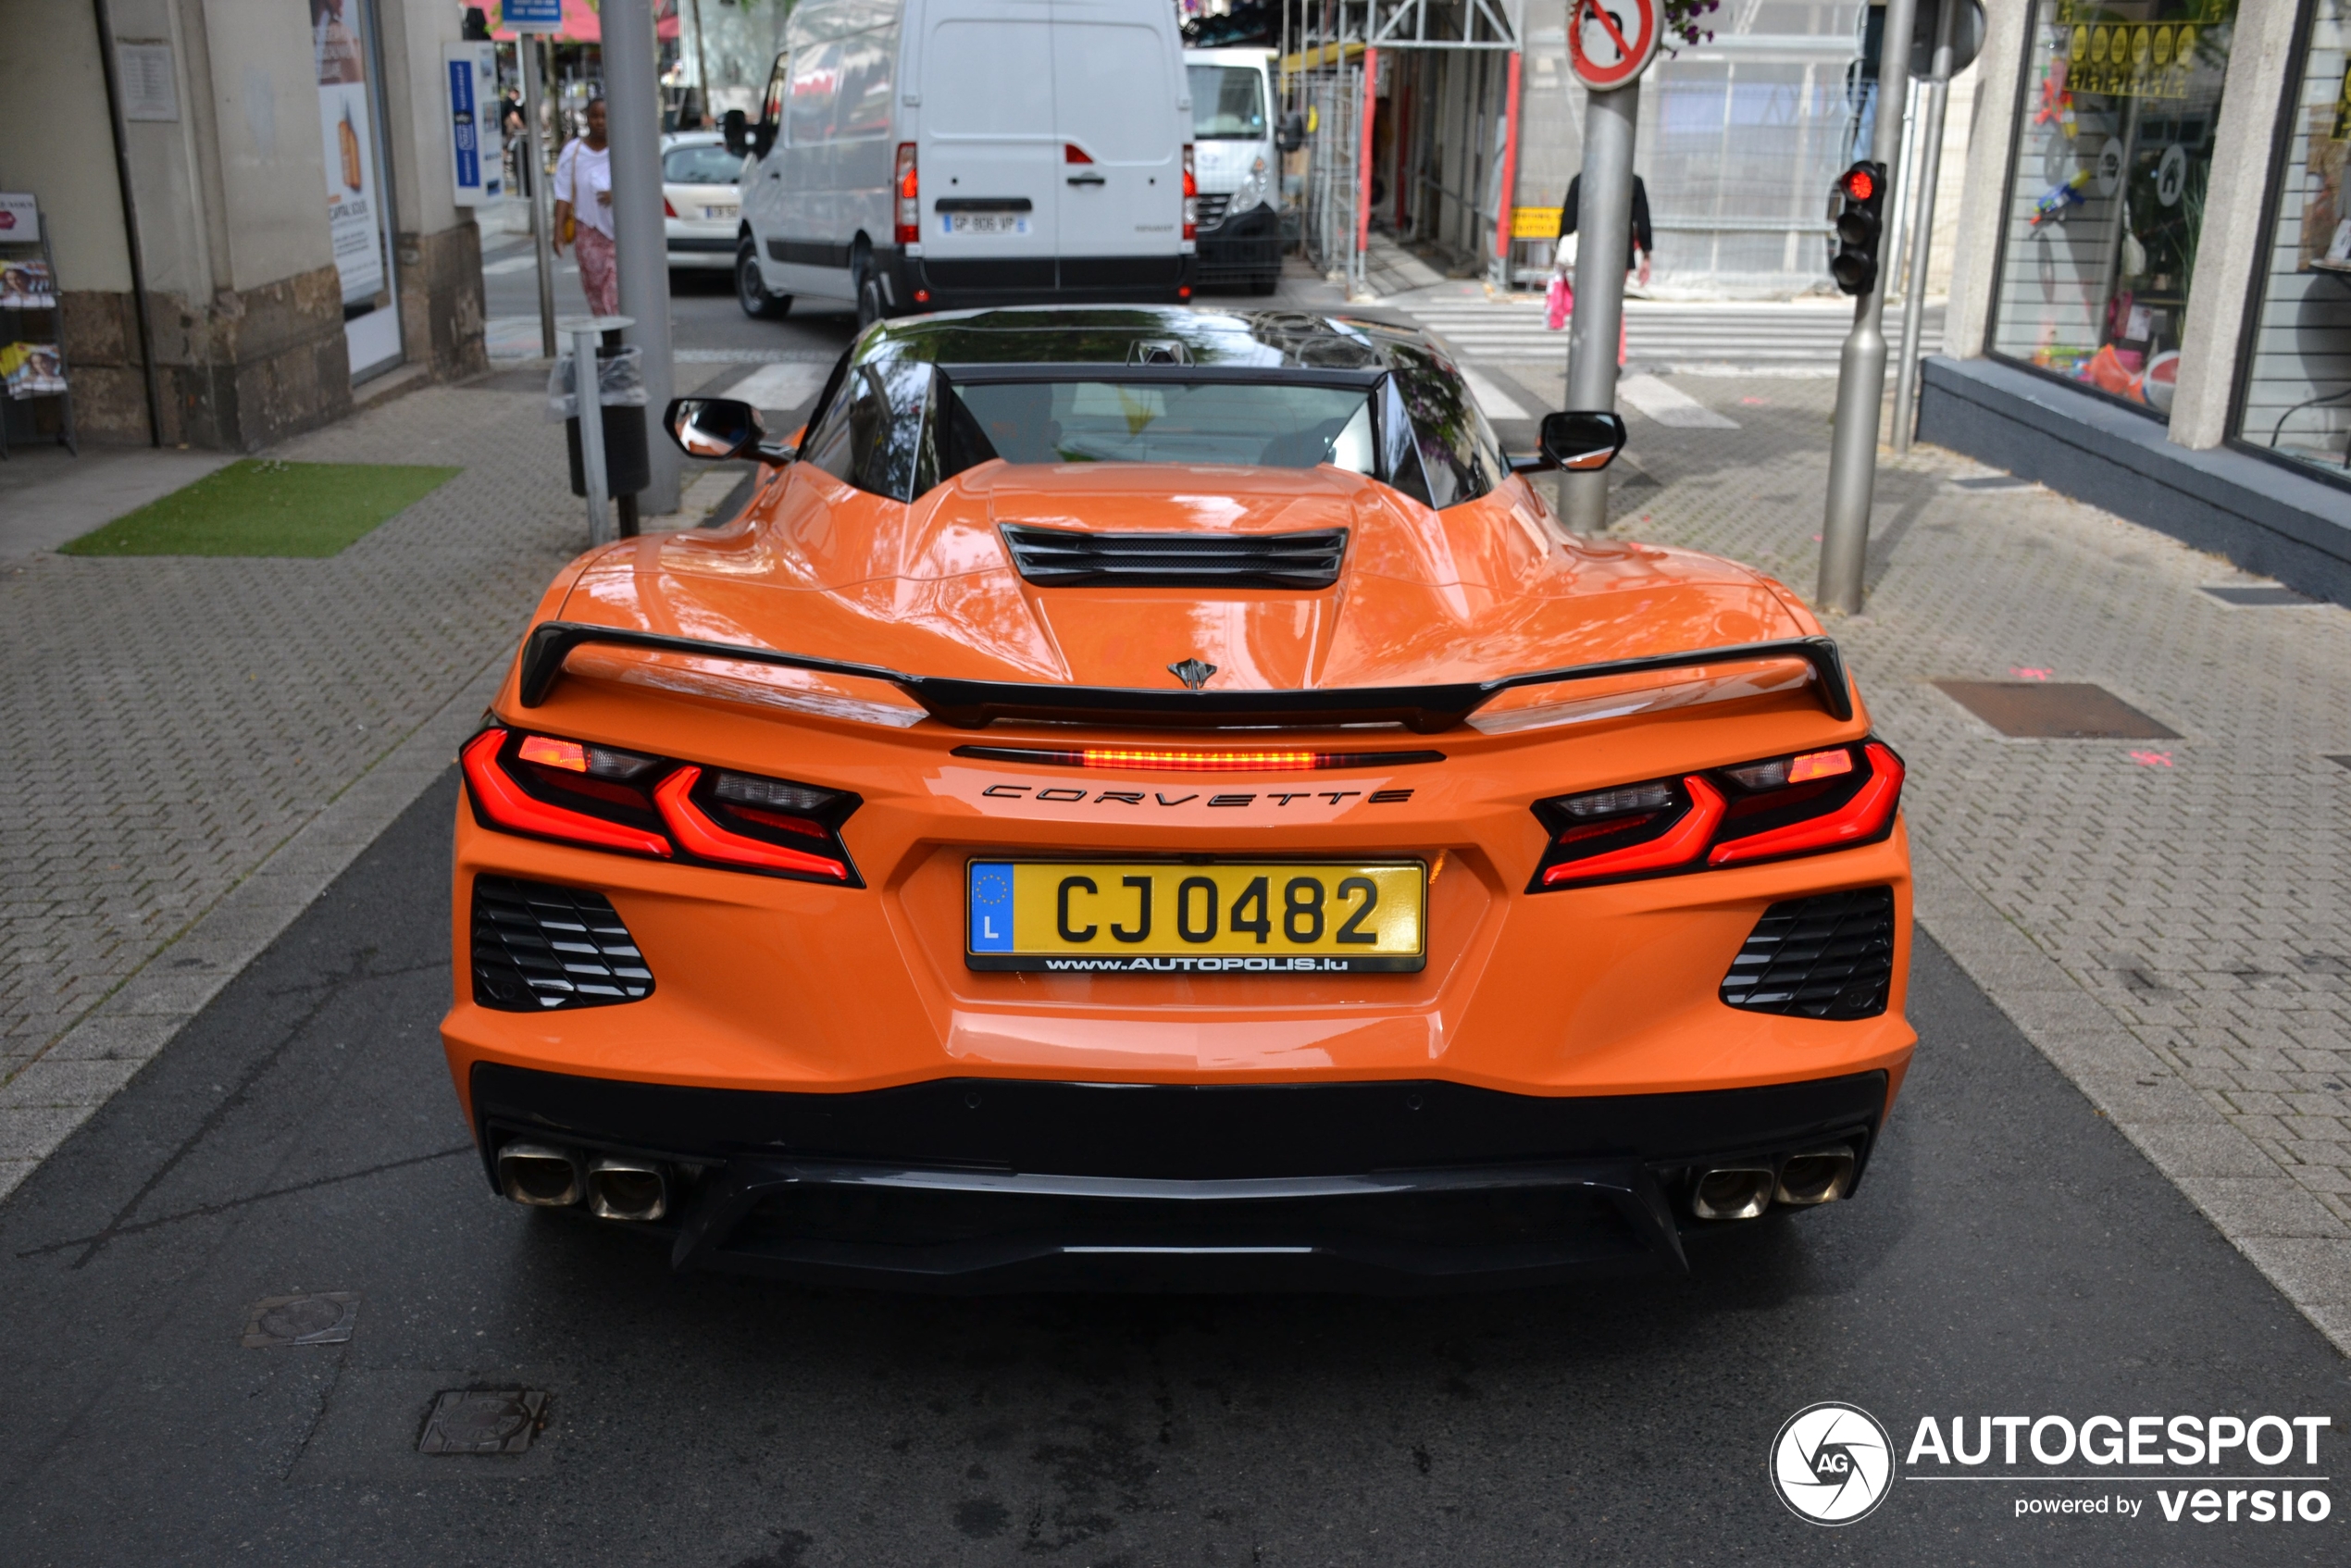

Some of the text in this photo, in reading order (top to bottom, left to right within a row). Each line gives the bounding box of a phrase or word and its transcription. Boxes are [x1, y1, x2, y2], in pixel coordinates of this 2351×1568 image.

[981, 783, 1416, 808] CORVETTE
[984, 916, 999, 939] L
[1045, 956, 1349, 971] www.AUTOPOLIS.lu
